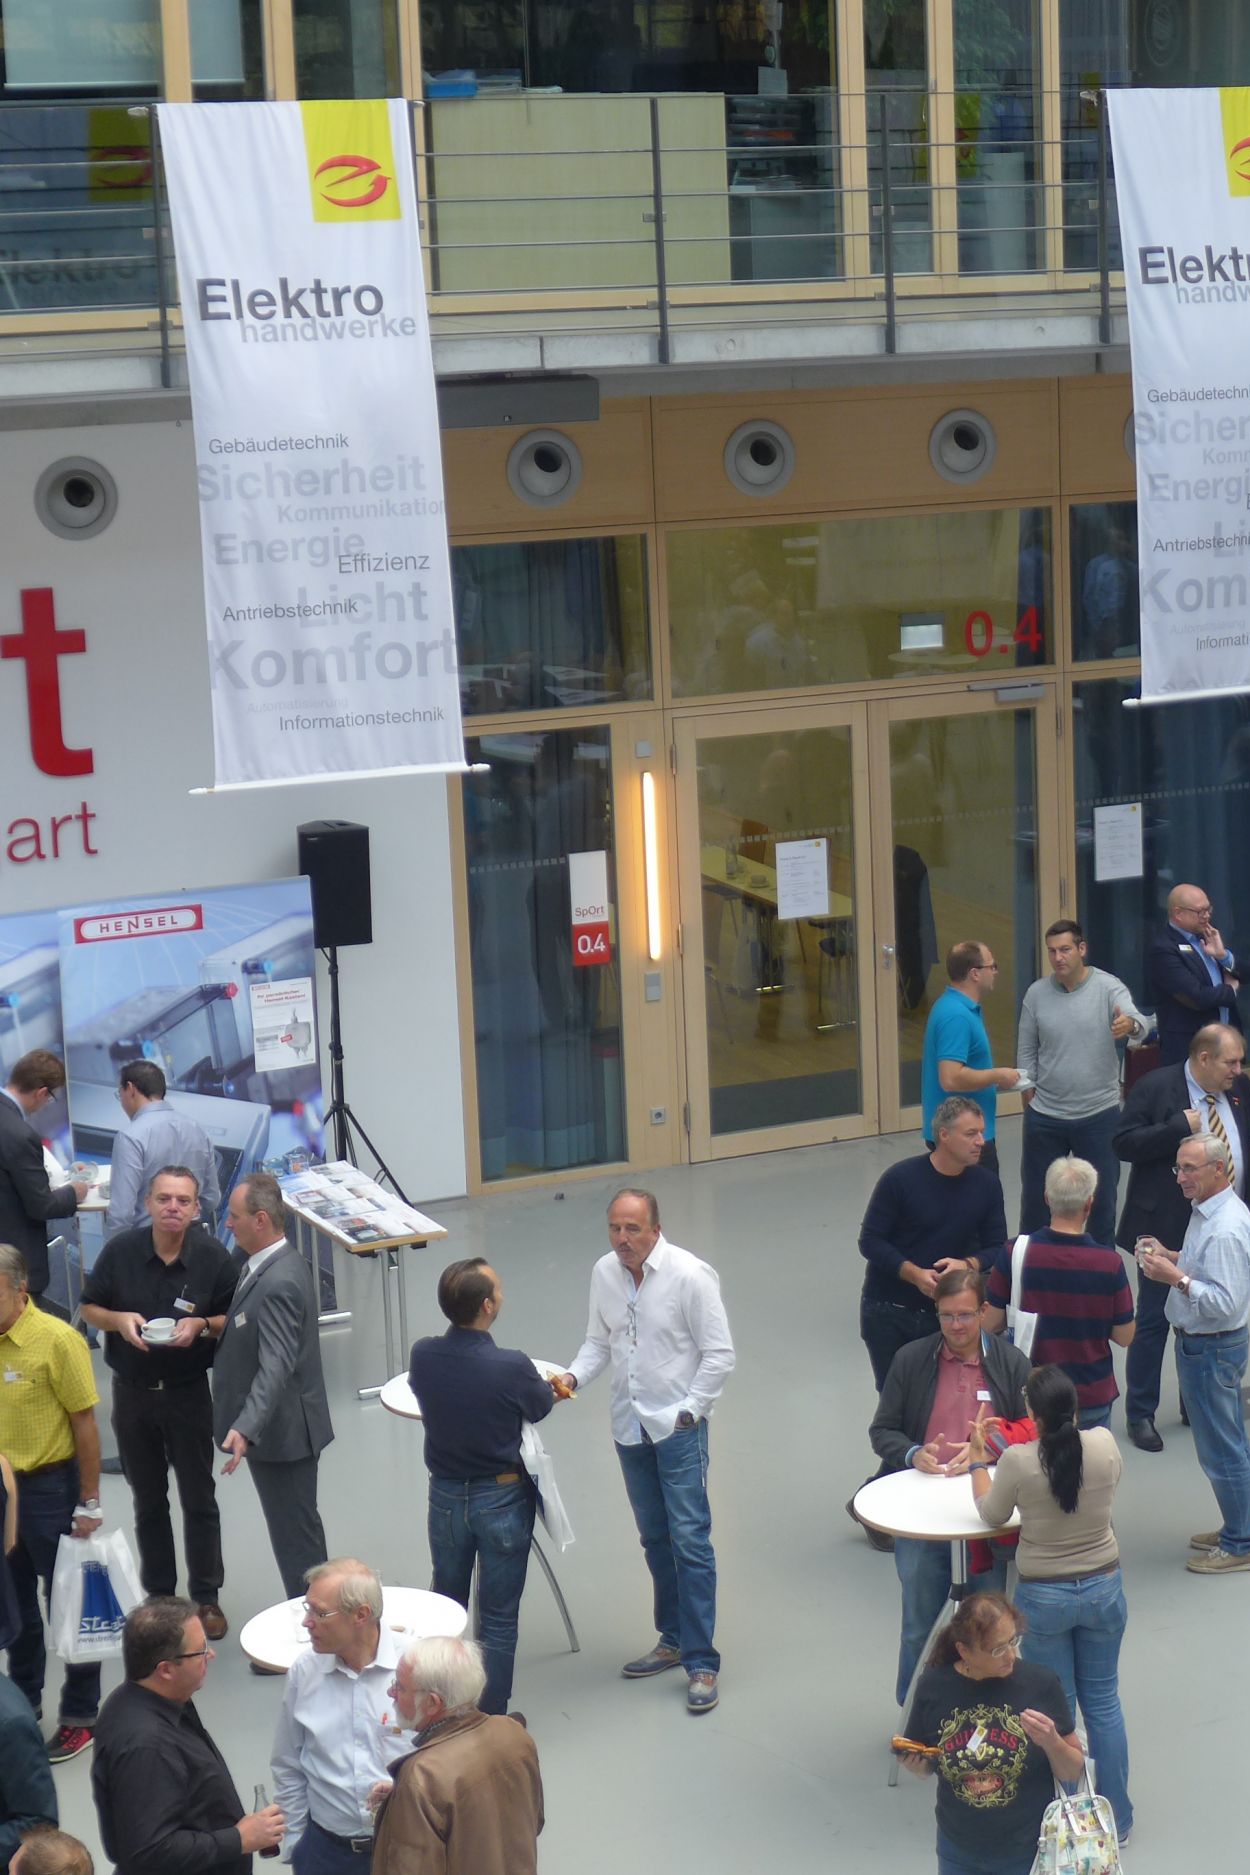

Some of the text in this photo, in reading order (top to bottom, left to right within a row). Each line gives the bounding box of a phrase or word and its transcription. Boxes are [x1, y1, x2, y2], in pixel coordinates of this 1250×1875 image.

[195, 277, 384, 321] Elektro
[239, 312, 417, 343] handwerke
[208, 433, 350, 455] Gebäudetechnik
[197, 455, 426, 502] Sicherheit
[213, 527, 366, 567] Energie
[338, 553, 430, 574] Effizienz
[222, 598, 358, 622] Antriebstechnik
[298, 581, 429, 628] Licht
[964, 604, 1042, 658] 0.4
[208, 627, 458, 691] Komfort
[279, 706, 445, 731] Informationstechnik
[99, 915, 178, 933] HENSEL
[575, 906, 604, 917] SpOrt
[577, 932, 606, 954] 0.4
[945, 1728, 1018, 1751] GUIESS
